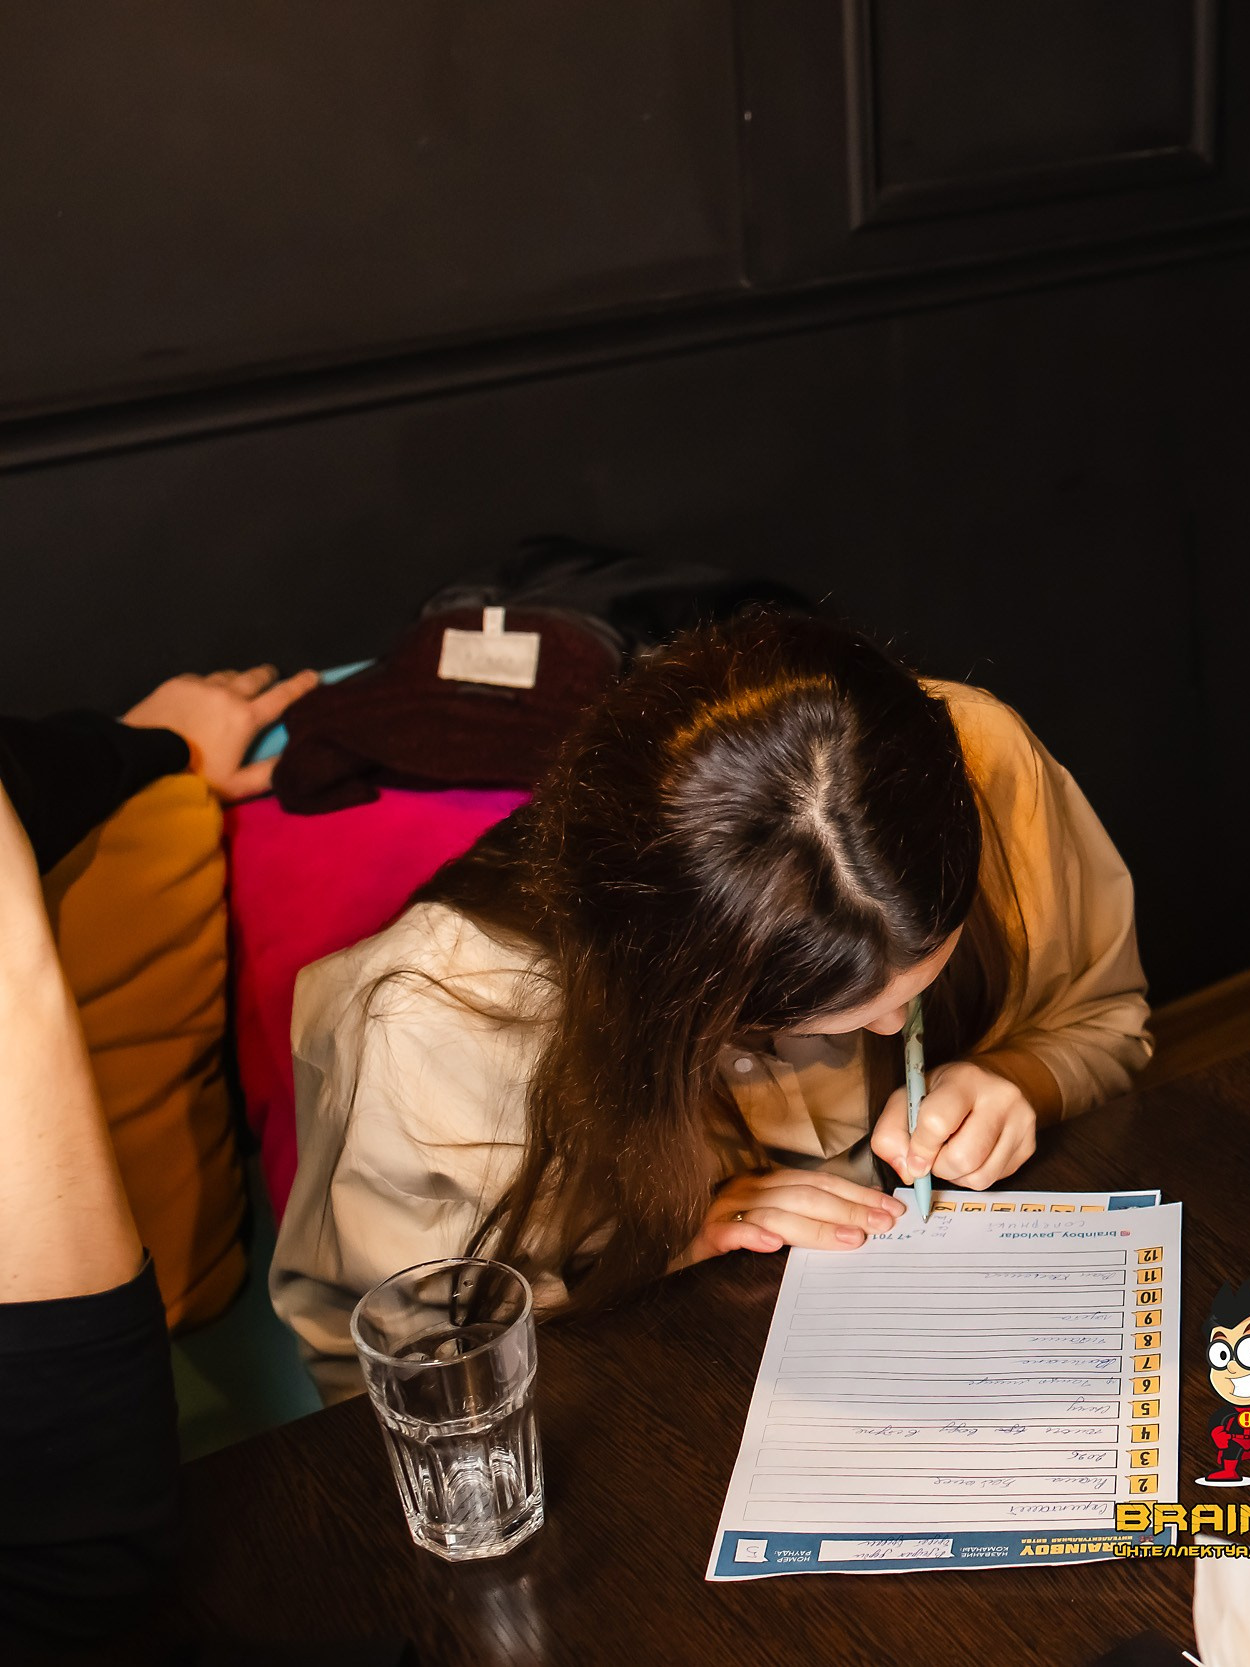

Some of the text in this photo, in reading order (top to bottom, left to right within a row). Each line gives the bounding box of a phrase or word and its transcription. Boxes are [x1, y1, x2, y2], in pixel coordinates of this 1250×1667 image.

[998, 1230, 1118, 1240] brainboy_pavlodar
[1143, 1250, 1158, 1262] 12
[1144, 1270, 1157, 1282] 11
[1140, 1292, 1158, 1304] 10
[1144, 1312, 1152, 1325] 9
[1144, 1334, 1152, 1346] 8
[1142, 1357, 1152, 1370] 7
[1142, 1380, 1151, 1392] 6
[1140, 1402, 1150, 1416] 5
[1141, 1426, 1151, 1440] 4
[1140, 1452, 1150, 1466] 3
[1138, 1478, 1148, 1492] 2
[1051, 1536, 1133, 1544] ИНТЕЛЛЕКТУАЛЬНАЯ
[745, 1546, 760, 1558] 5
